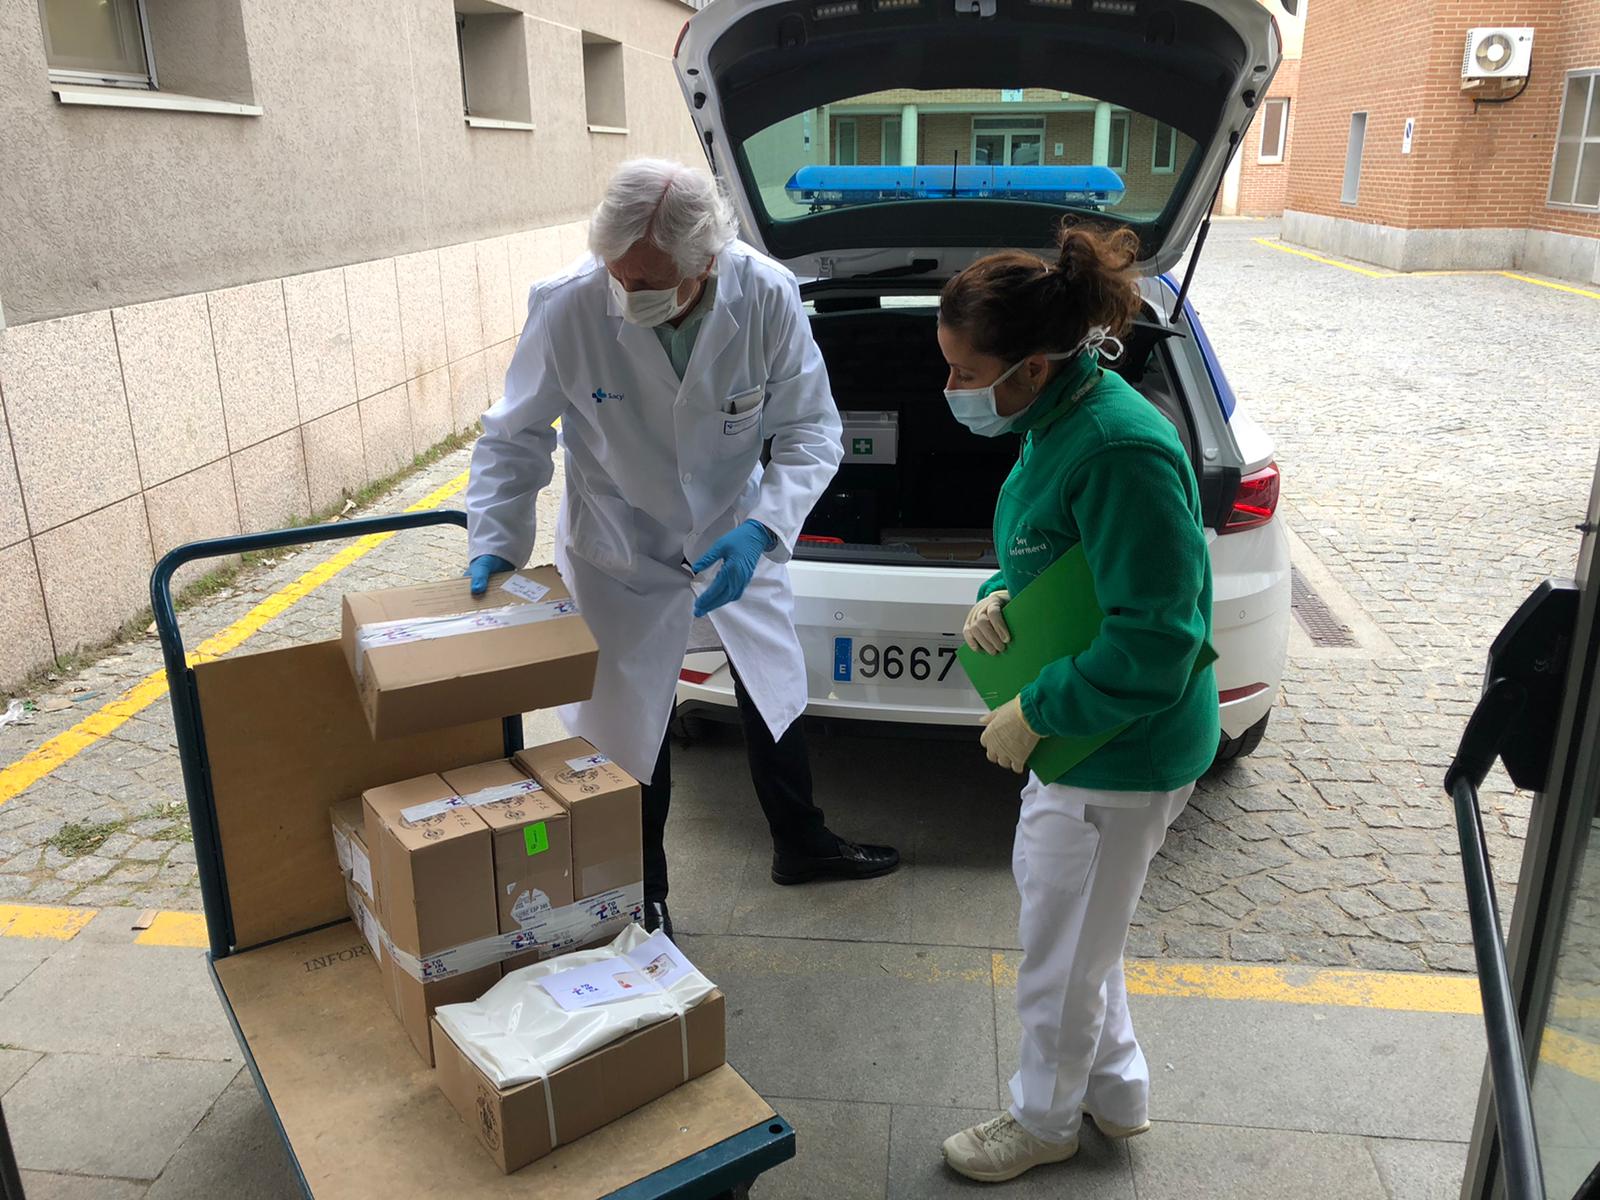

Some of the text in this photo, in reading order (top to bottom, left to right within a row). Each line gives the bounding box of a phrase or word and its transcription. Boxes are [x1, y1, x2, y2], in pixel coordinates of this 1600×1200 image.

[839, 664, 846, 674] E
[858, 644, 958, 682] 9667
[303, 943, 368, 973] INFOR
